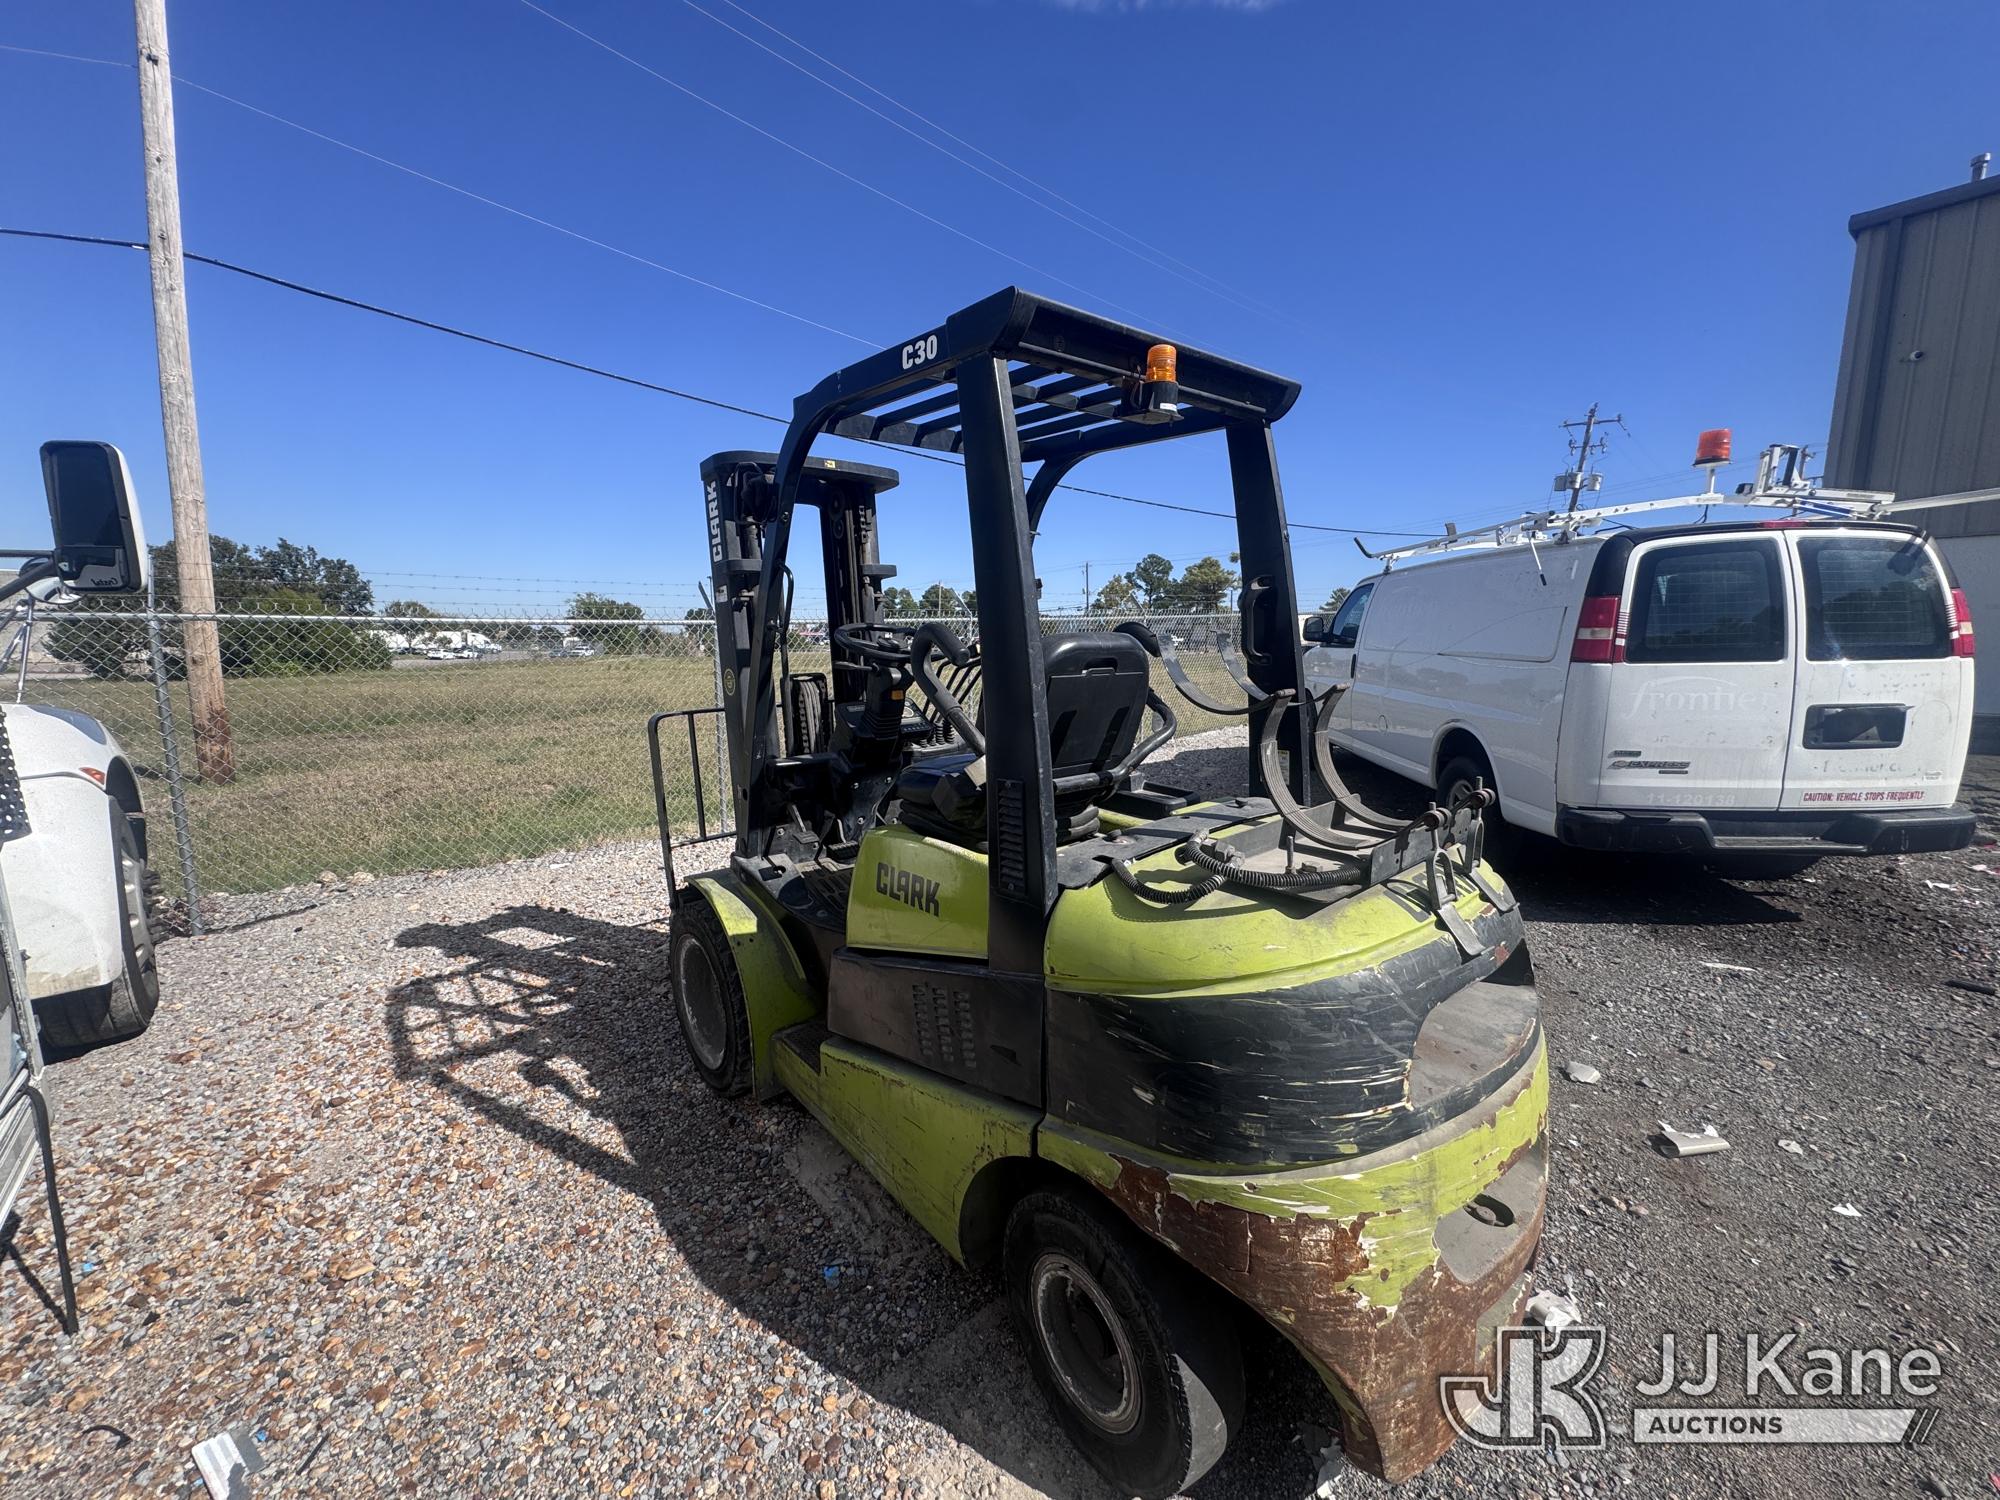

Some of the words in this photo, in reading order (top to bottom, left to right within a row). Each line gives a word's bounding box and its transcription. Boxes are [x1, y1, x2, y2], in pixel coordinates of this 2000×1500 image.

[902, 334, 938, 370] C30
[706, 480, 723, 563] CLARK
[1628, 761, 1691, 769] EXPRESS
[1803, 792, 1835, 802] CAUTION:
[1836, 791, 1862, 801] VEHICLE
[1865, 791, 1884, 801] STOPS
[1885, 790, 1925, 801] FREQUENTLY
[876, 862, 940, 917] CLARK
